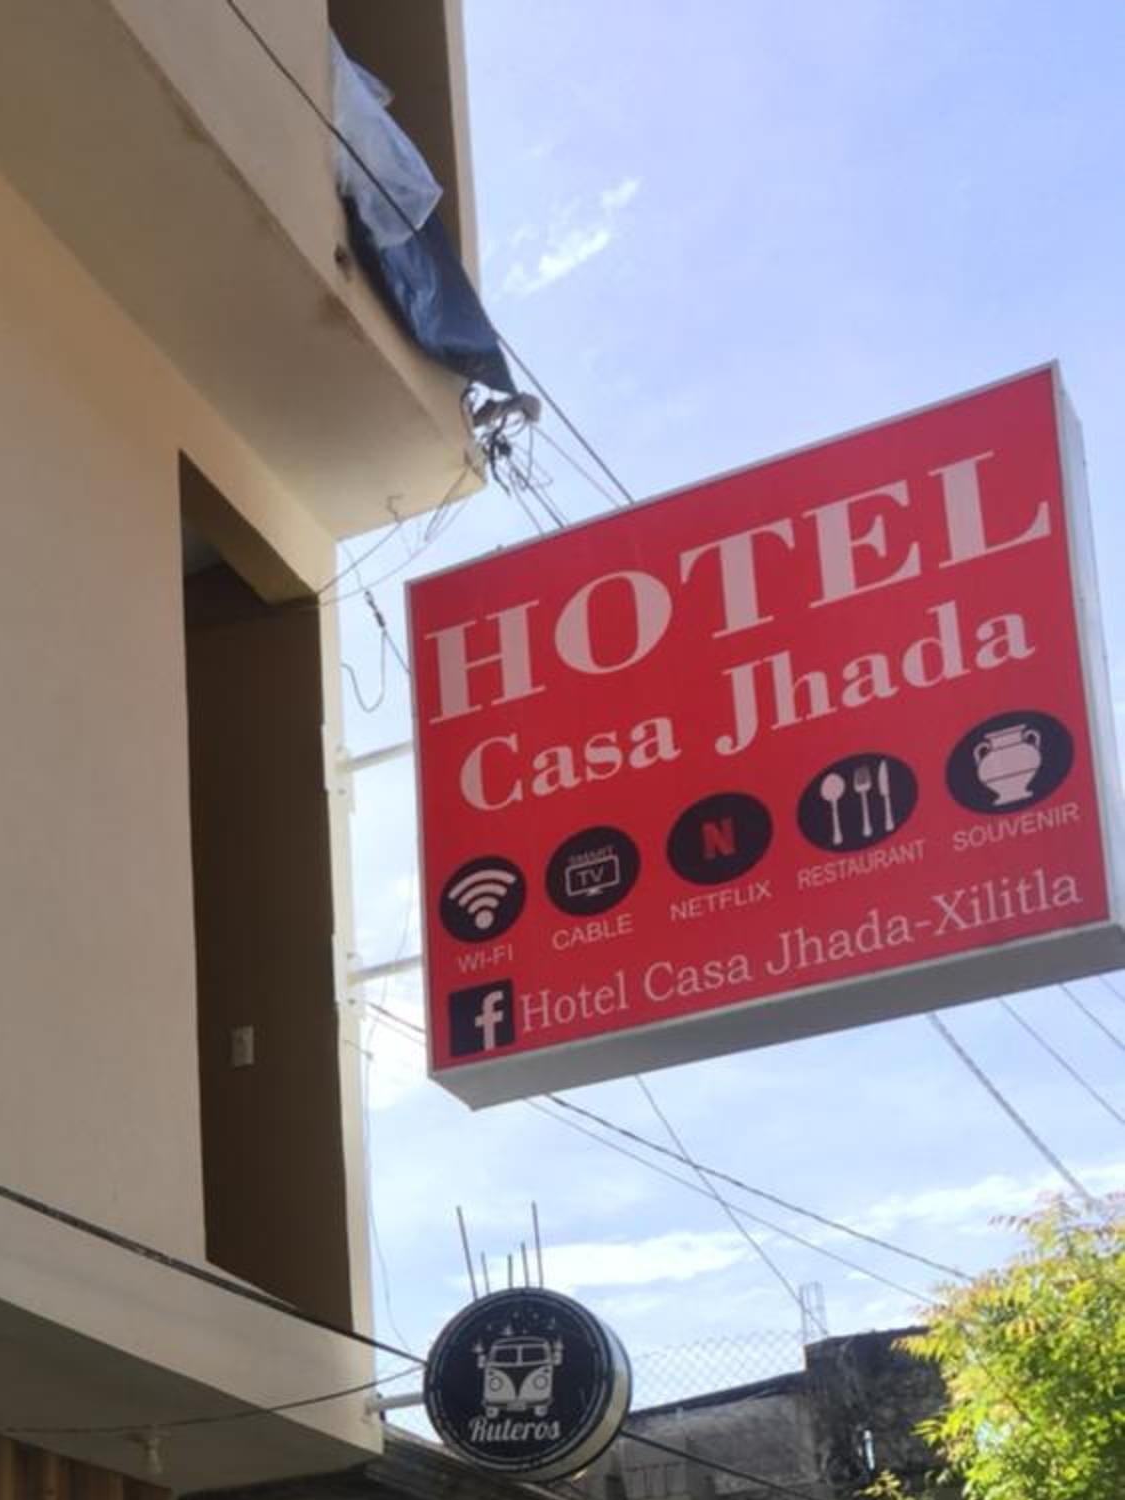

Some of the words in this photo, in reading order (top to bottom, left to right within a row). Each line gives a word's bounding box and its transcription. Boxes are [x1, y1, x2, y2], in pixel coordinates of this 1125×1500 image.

[424, 450, 1053, 724] HOTEL
[460, 713, 681, 812] Casa
[715, 600, 1036, 756] Jhada
[701, 817, 736, 861] N
[952, 802, 1081, 852] SOUVENIR
[576, 866, 604, 886] TV
[796, 839, 925, 890] RESTAURANT
[669, 880, 772, 921] NETFLIX
[520, 971, 630, 1033] Hotel
[643, 953, 753, 1002] Casa
[764, 868, 1084, 976] Jhada-Xilitla
[552, 913, 634, 951] CABLE
[457, 944, 514, 974] WI-FI
[469, 1414, 561, 1442] Ruteros
